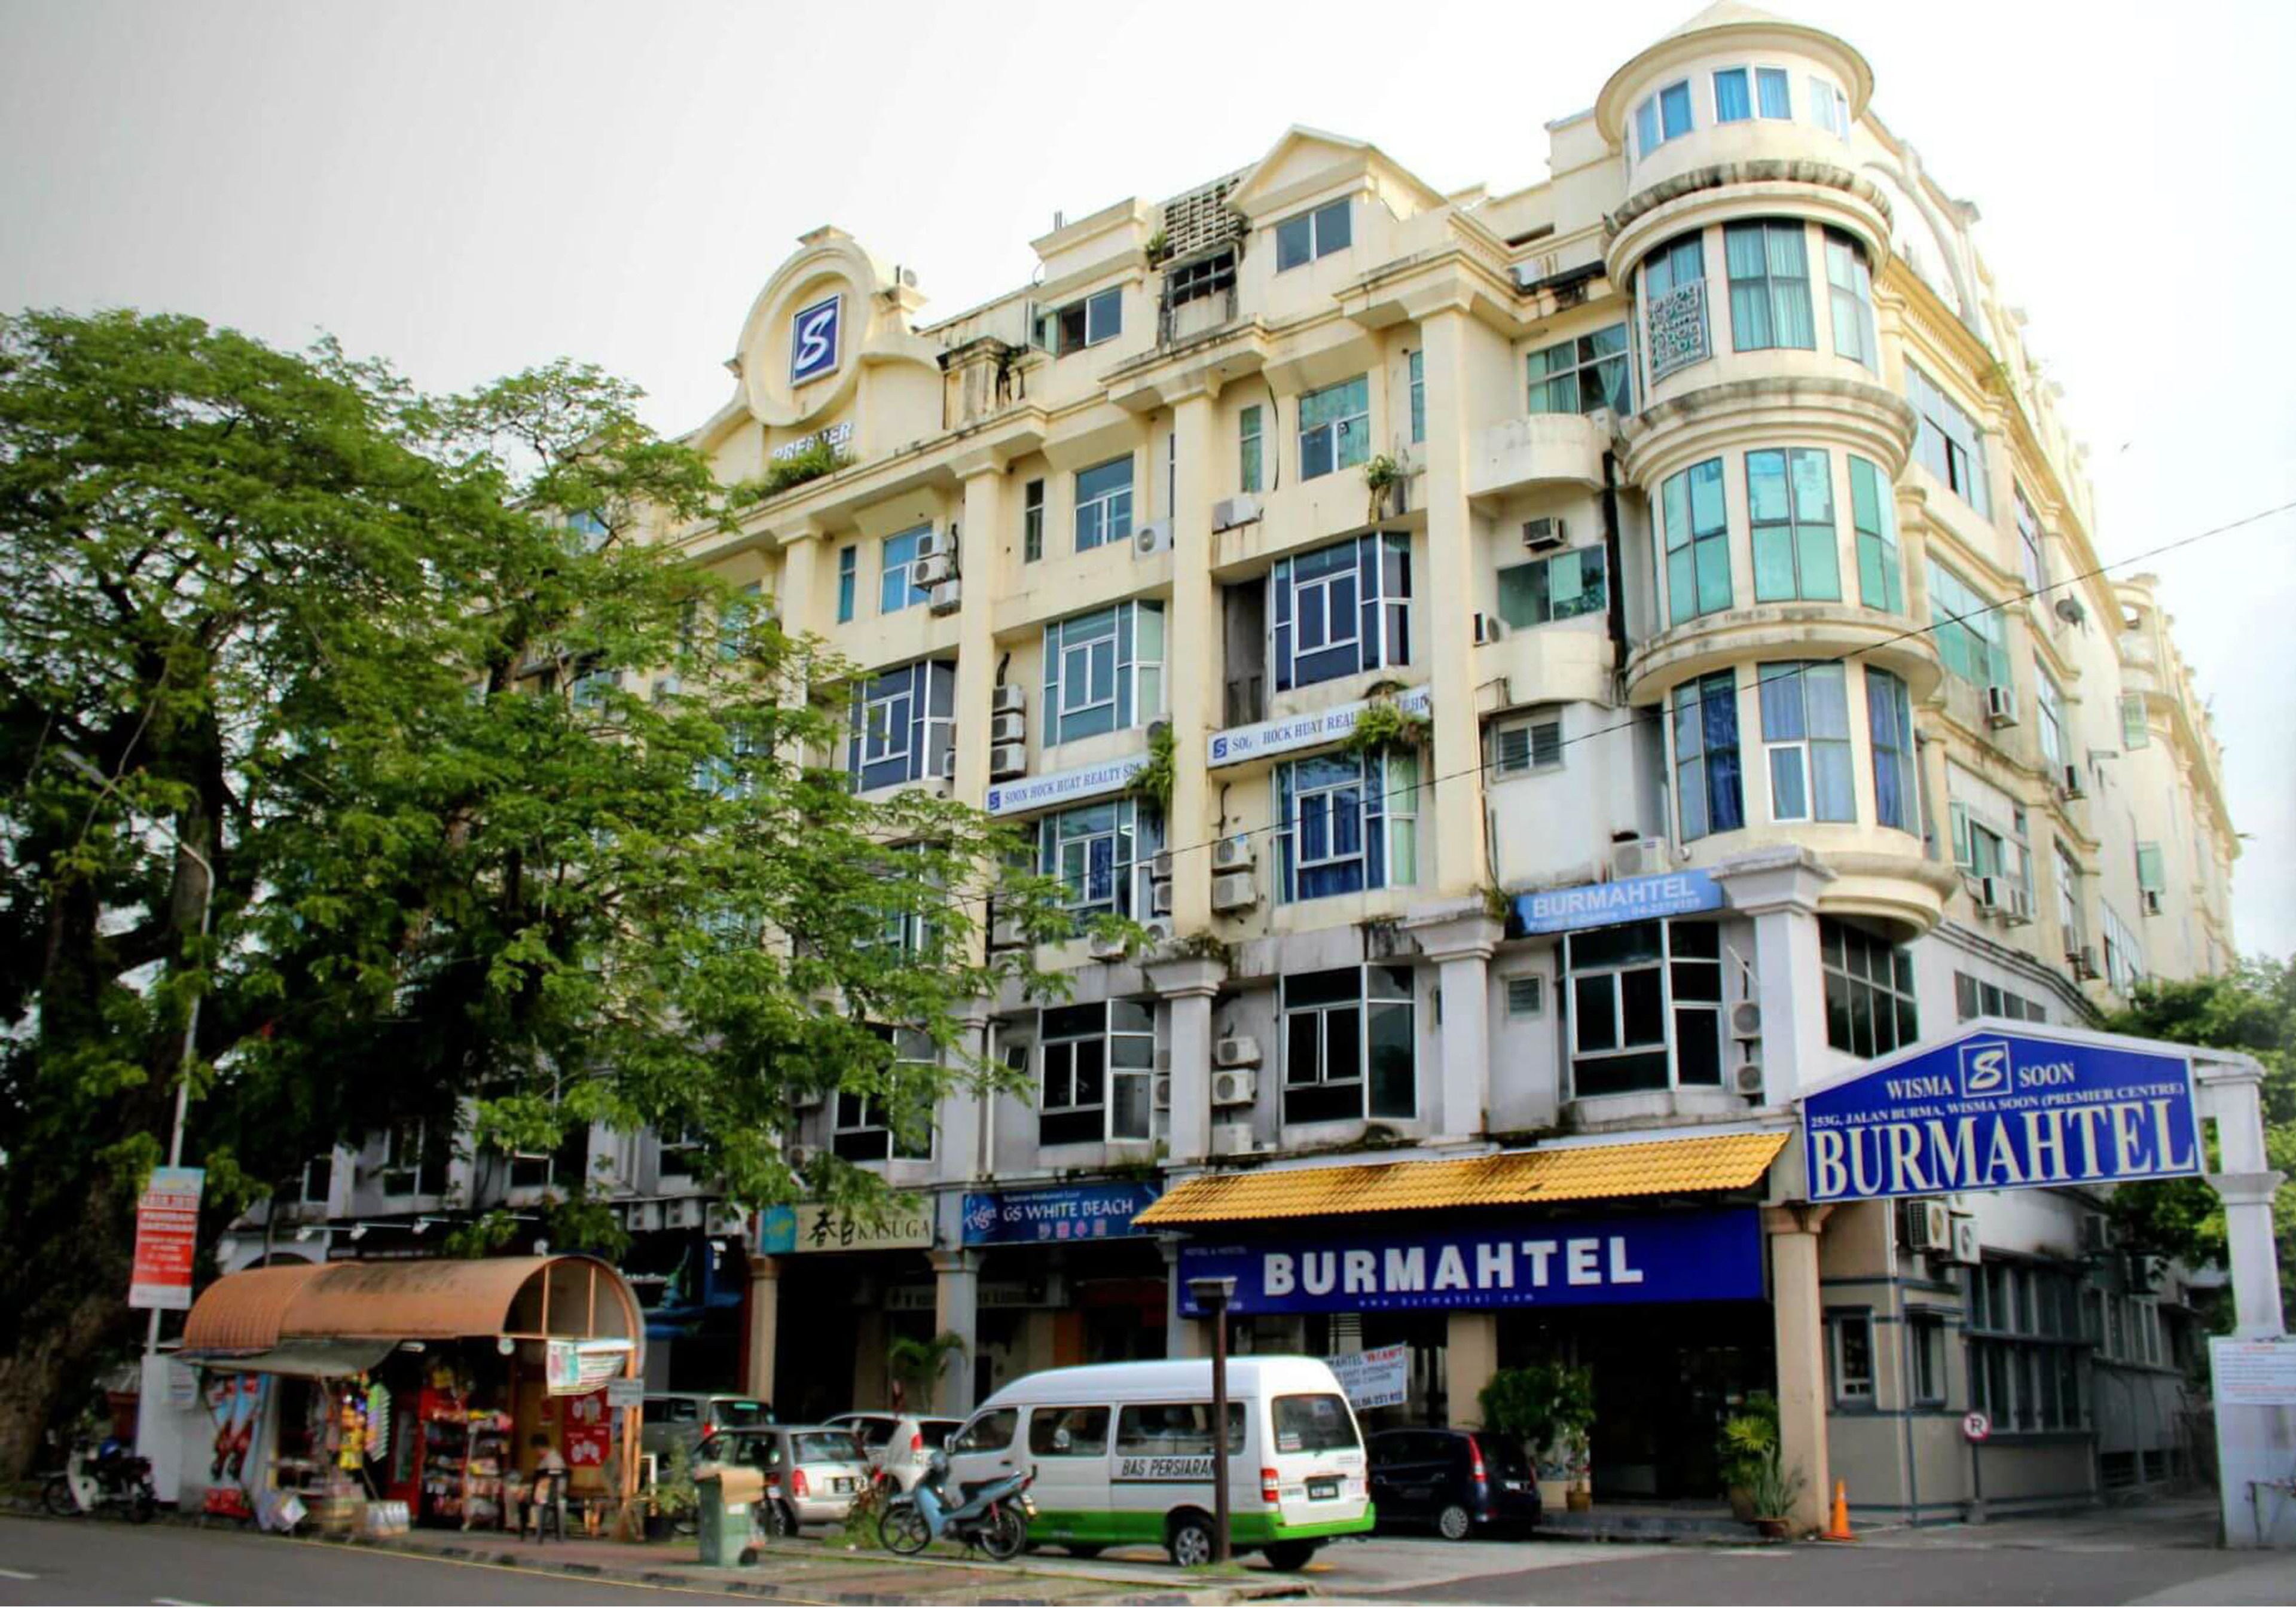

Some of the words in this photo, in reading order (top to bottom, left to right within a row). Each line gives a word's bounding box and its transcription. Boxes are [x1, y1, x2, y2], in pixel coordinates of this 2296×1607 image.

[1263, 726, 1291, 744] HOCK
[1294, 719, 1323, 738] HUAT
[1057, 775, 1081, 793] HUAT
[1083, 767, 1120, 787] REALTY
[1532, 876, 1697, 918] BURMAHTEL
[1885, 1075, 1954, 1101] WISMA
[2018, 1062, 2075, 1088] SOON
[1846, 1110, 1889, 1125] JALAN
[1891, 1105, 1946, 1121] BURMA,
[1946, 1098, 1996, 1114] WISMA
[1998, 1095, 2039, 1110] SOON
[2042, 1089, 2114, 1107] (PREMIER
[2117, 1081, 2185, 1099] CENTRE)
[1811, 1099, 2195, 1198] BURMAHTEL
[1003, 1205, 1022, 1222] GS
[1025, 1200, 1077, 1220] WHITE
[1082, 1198, 1134, 1217] BEACH
[1263, 1237, 1644, 1296] BURMAHTEL
[1122, 1458, 1146, 1477] BAS
